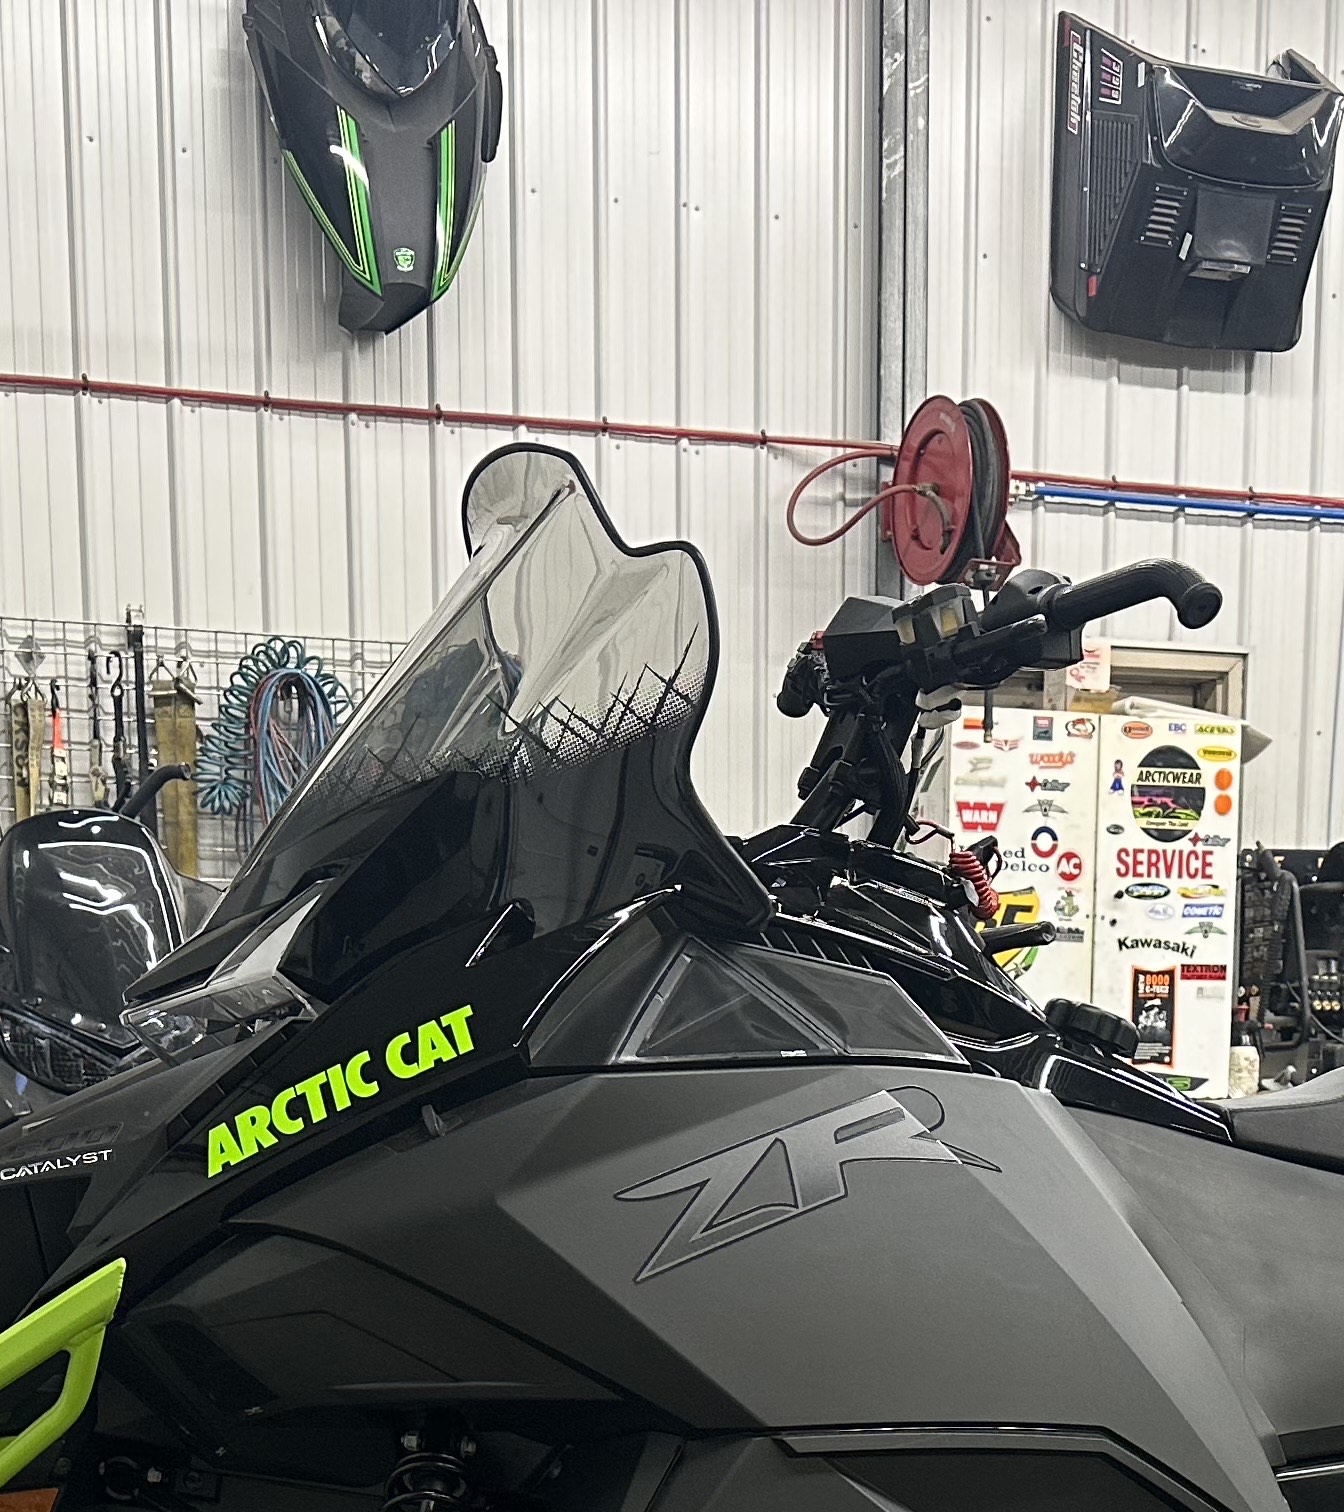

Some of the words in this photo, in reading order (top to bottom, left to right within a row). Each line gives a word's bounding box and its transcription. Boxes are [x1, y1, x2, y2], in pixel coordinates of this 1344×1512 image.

[1136, 770, 1202, 785] ARCTICWEAR
[961, 809, 998, 823] WARN
[1057, 857, 1080, 875] AC
[1116, 847, 1214, 879] SERVICE
[1117, 936, 1197, 958] Kawasaki
[1181, 965, 1227, 973] TEXTRON
[207, 1050, 380, 1178] ARCTIC
[385, 1004, 477, 1080] CAT
[0, 1149, 113, 1181] CATALYST
[613, 1085, 1002, 1284] ZR
